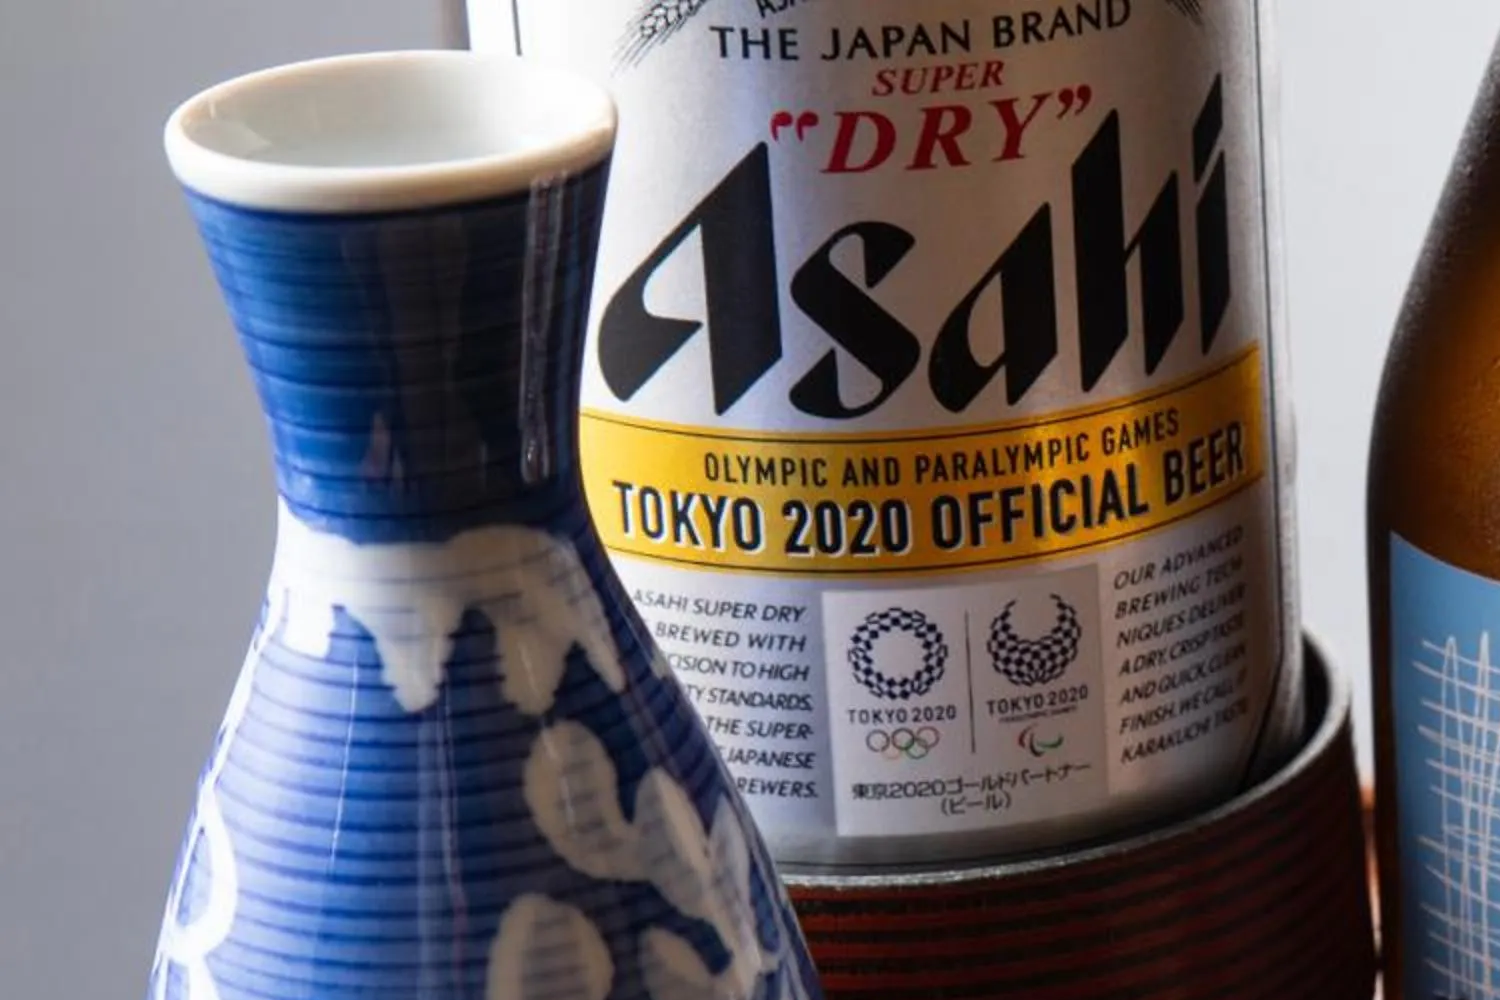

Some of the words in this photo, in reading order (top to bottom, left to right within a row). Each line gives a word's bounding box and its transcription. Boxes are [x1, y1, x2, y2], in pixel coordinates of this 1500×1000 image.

[708, 25, 800, 61] THE
[819, 19, 972, 61] JAPAN
[992, 0, 1132, 49] BRAND
[871, 59, 1005, 98] SUPER
[597, 71, 1232, 420] Asahi
[703, 451, 829, 489] OLYMPIC
[841, 455, 901, 488] AND
[913, 432, 1091, 485] PARALYMPIC
[1101, 408, 1181, 457] GAMES
[611, 479, 764, 556] TOKYO
[782, 497, 910, 557] 2020
[930, 461, 1150, 551] OFFICIAL
[1163, 420, 1246, 506] BEER
[1113, 562, 1156, 591] OUR
[633, 588, 688, 613] ASAHI
[692, 597, 757, 621] SUPER
[760, 604, 808, 624] DRY
[1115, 575, 1201, 620] BREWING
[654, 620, 740, 648] BREWED
[746, 631, 808, 653] WITH
[1116, 608, 1185, 649] NIQUES
[730, 660, 757, 679] TO
[757, 662, 811, 683] HIGH
[986, 693, 1044, 716] TOKYO
[1047, 685, 1090, 707] 2020
[1118, 680, 1157, 707] AND
[705, 714, 742, 736] THE
[847, 707, 909, 724] TOKYO
[911, 704, 958, 723] 2020
[727, 746, 817, 770] JAPANESE
[736, 776, 819, 799] REWERS.
[852, 764, 1092, 801] 東京2020ゴールドパートナー
